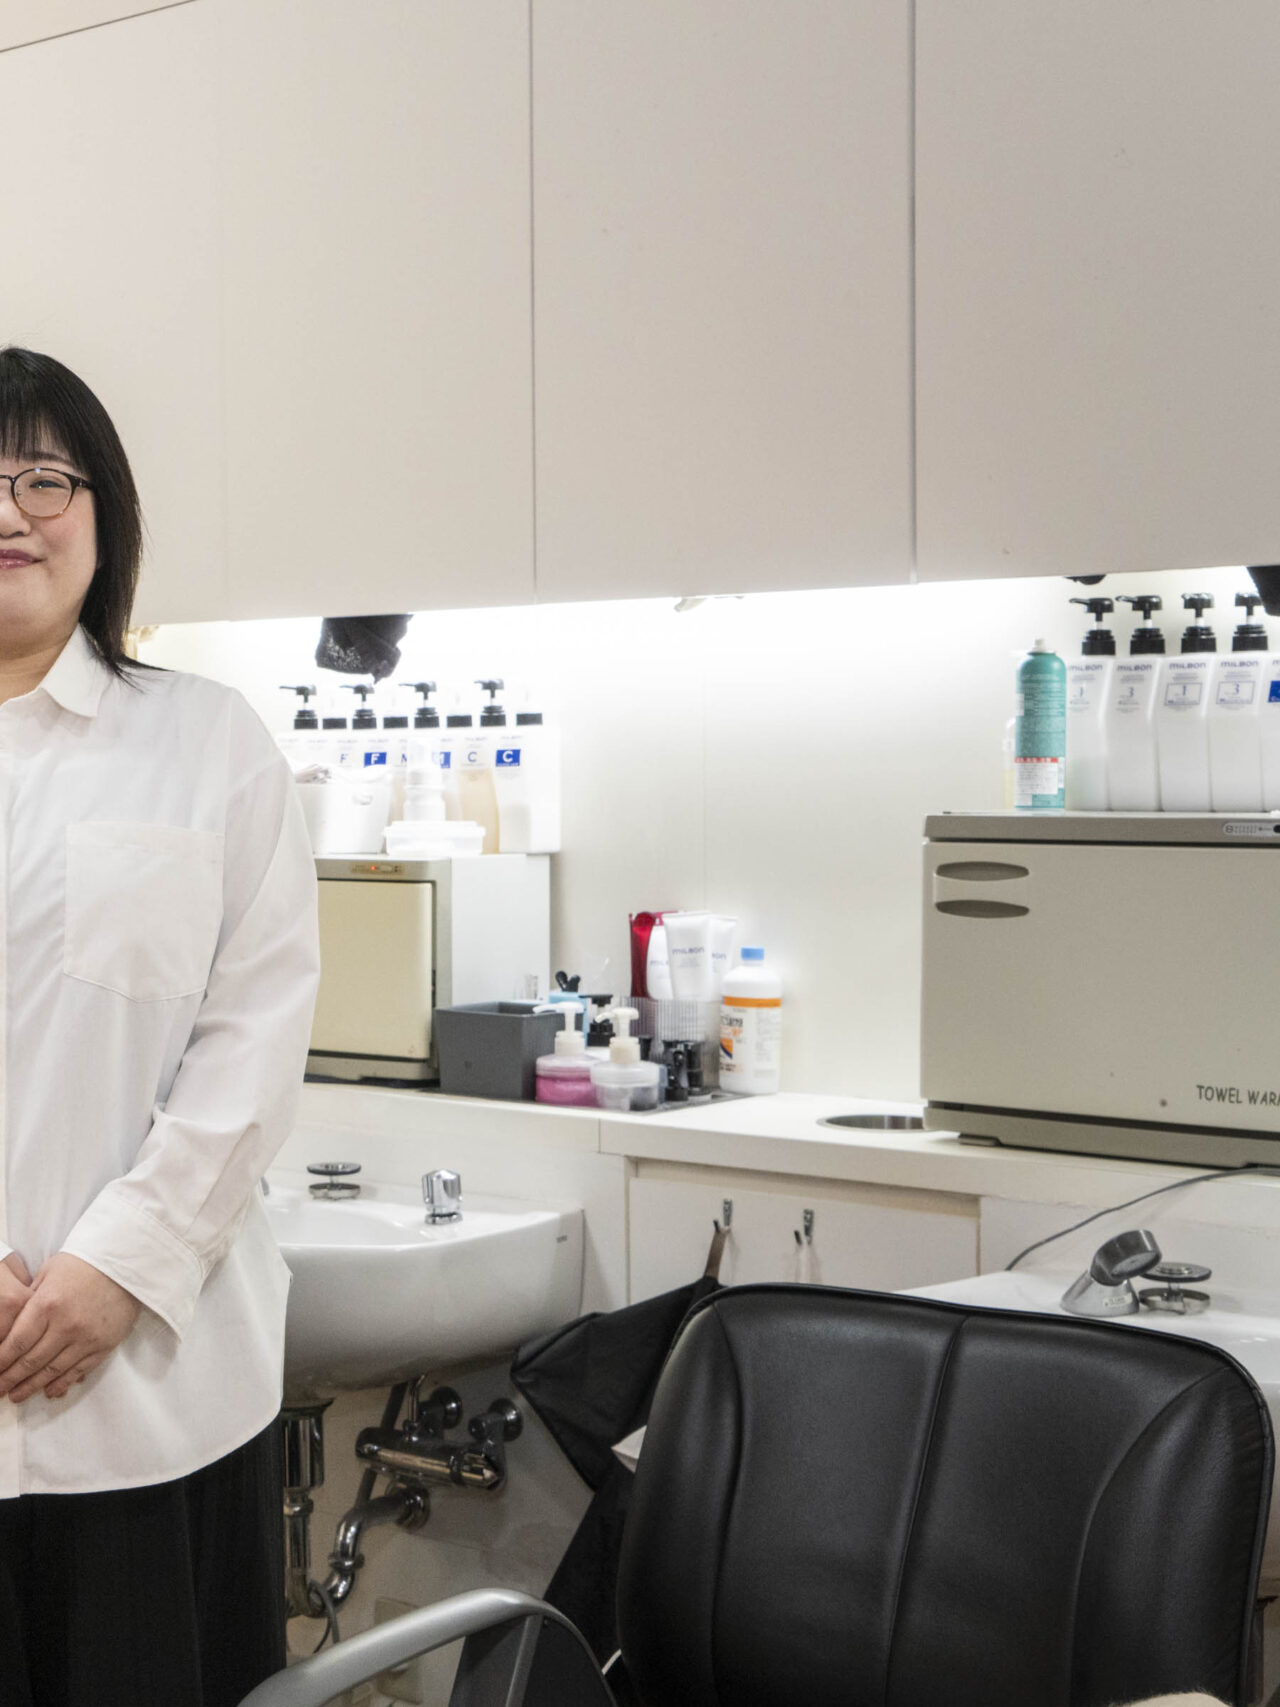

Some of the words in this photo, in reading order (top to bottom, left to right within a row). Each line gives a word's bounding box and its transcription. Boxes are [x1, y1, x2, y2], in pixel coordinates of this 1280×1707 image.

[371, 753, 380, 765] F
[467, 751, 478, 763] C
[502, 750, 514, 763] C
[1196, 1085, 1243, 1104] TOWEL
